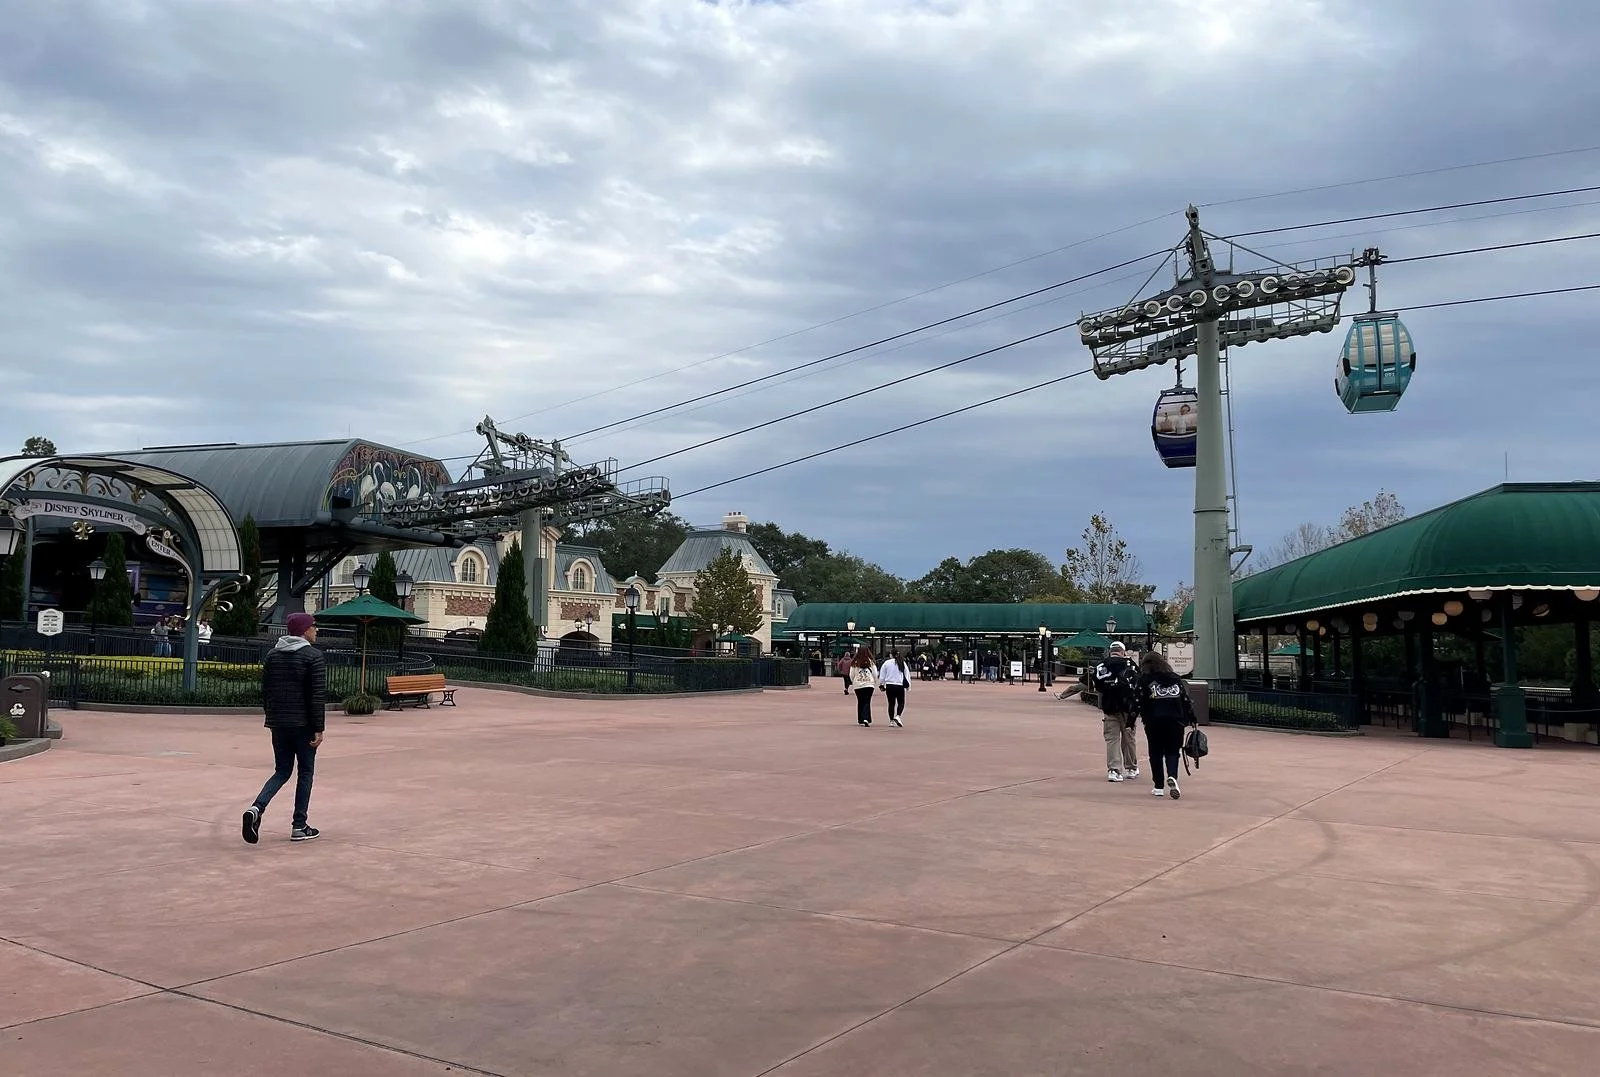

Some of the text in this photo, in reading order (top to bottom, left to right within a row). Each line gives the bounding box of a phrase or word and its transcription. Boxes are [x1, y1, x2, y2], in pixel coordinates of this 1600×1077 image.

[44, 502, 124, 522] DISNEY SKYLINER
[151, 541, 171, 556] ENTER
